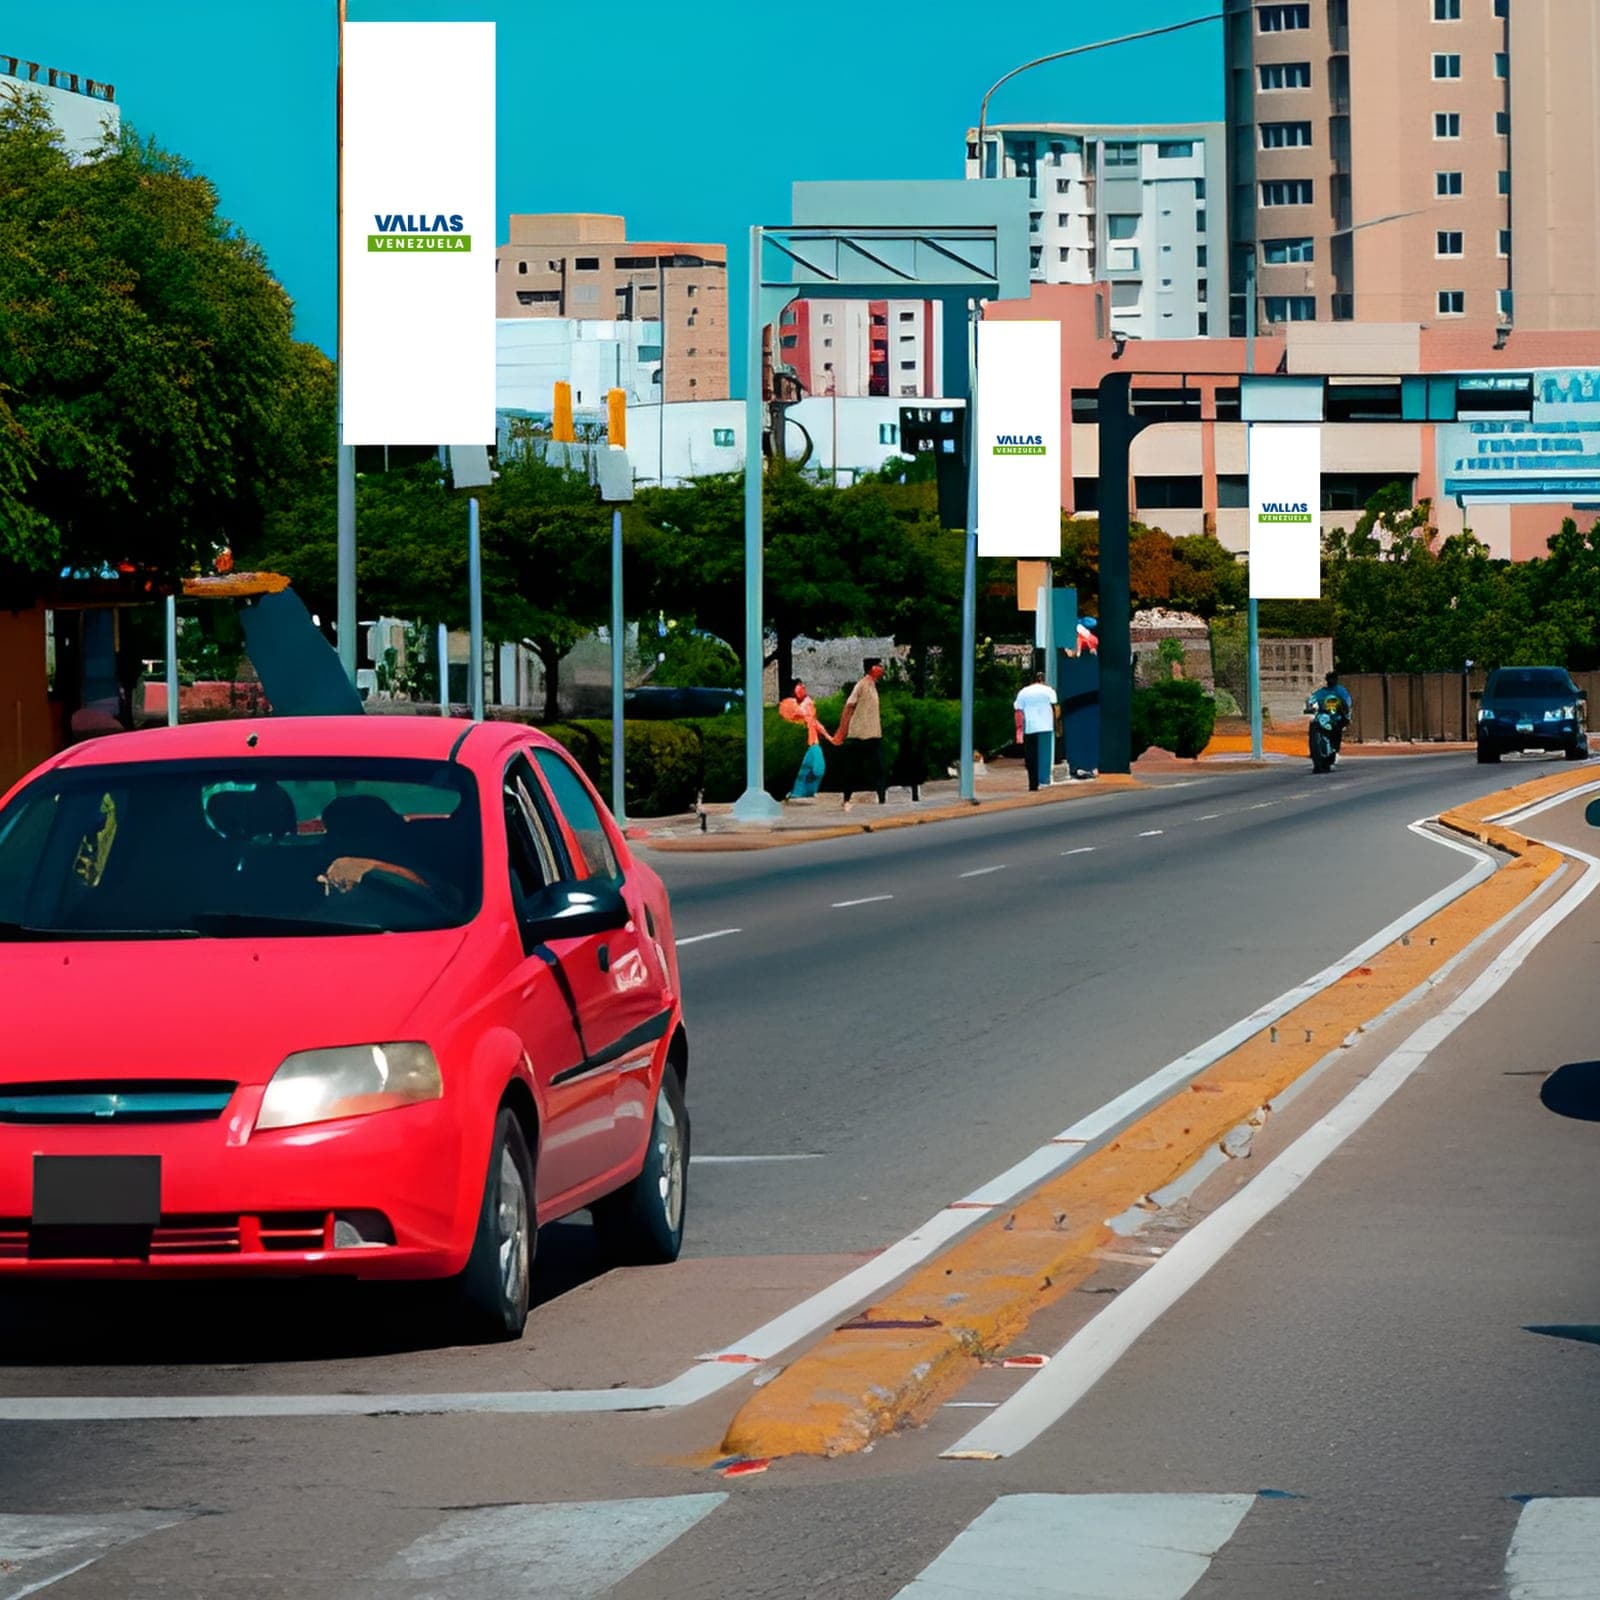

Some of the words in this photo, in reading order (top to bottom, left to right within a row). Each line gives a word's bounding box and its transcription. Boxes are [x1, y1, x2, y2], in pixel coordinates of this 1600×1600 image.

[374, 215, 464, 232] VALLAS
[375, 239, 464, 248] VENEZUELA
[996, 435, 1042, 445] VALLAS
[1262, 503, 1308, 513] VALLAS
